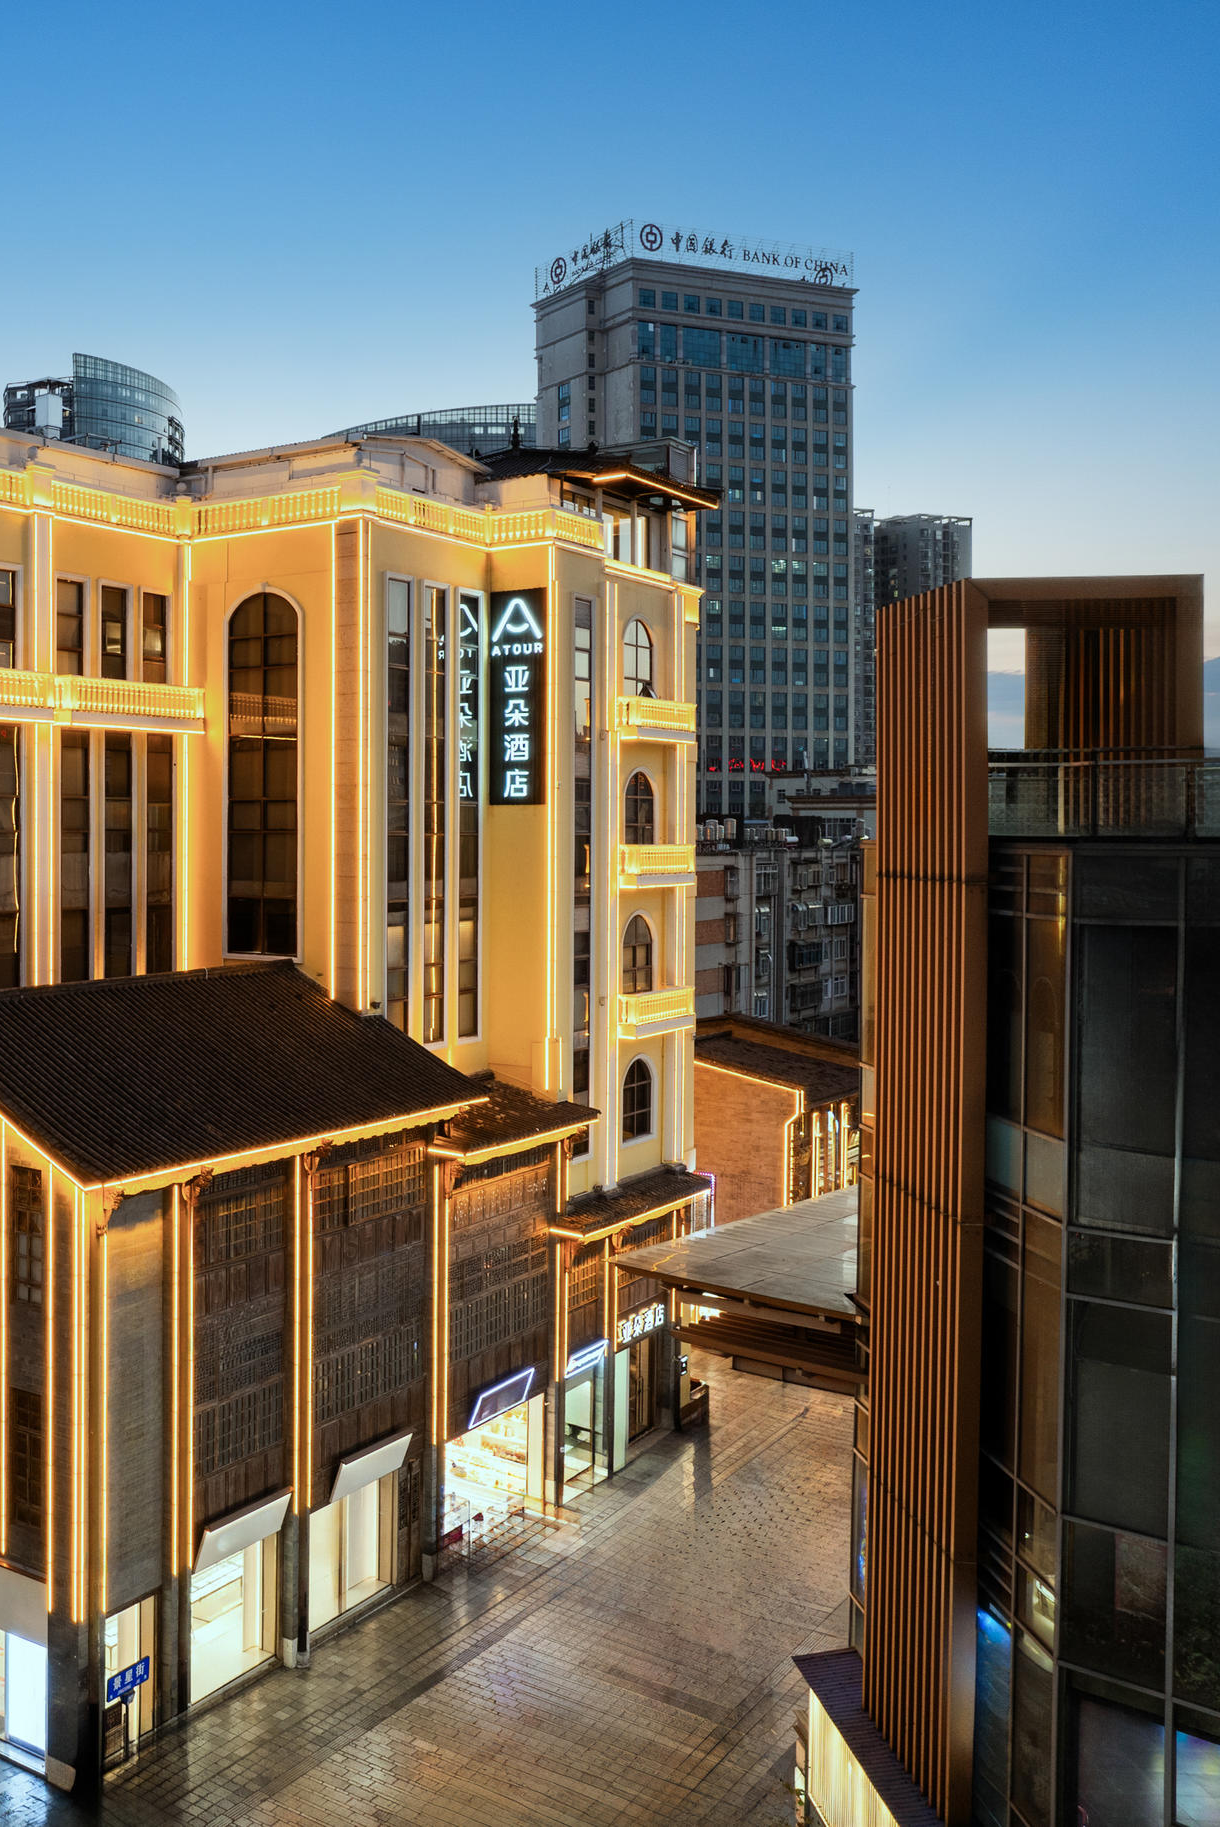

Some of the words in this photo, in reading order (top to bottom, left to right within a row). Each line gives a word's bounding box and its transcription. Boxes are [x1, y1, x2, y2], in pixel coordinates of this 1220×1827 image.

[671, 231, 734, 260] 中国银行
[743, 250, 780, 266] BANK
[784, 256, 801, 268] OF
[805, 259, 849, 276] CHINA
[491, 642, 543, 657] ATOUR
[504, 666, 529, 798] 亚朵酒店
[622, 1303, 665, 1344] 亚朵酒店
